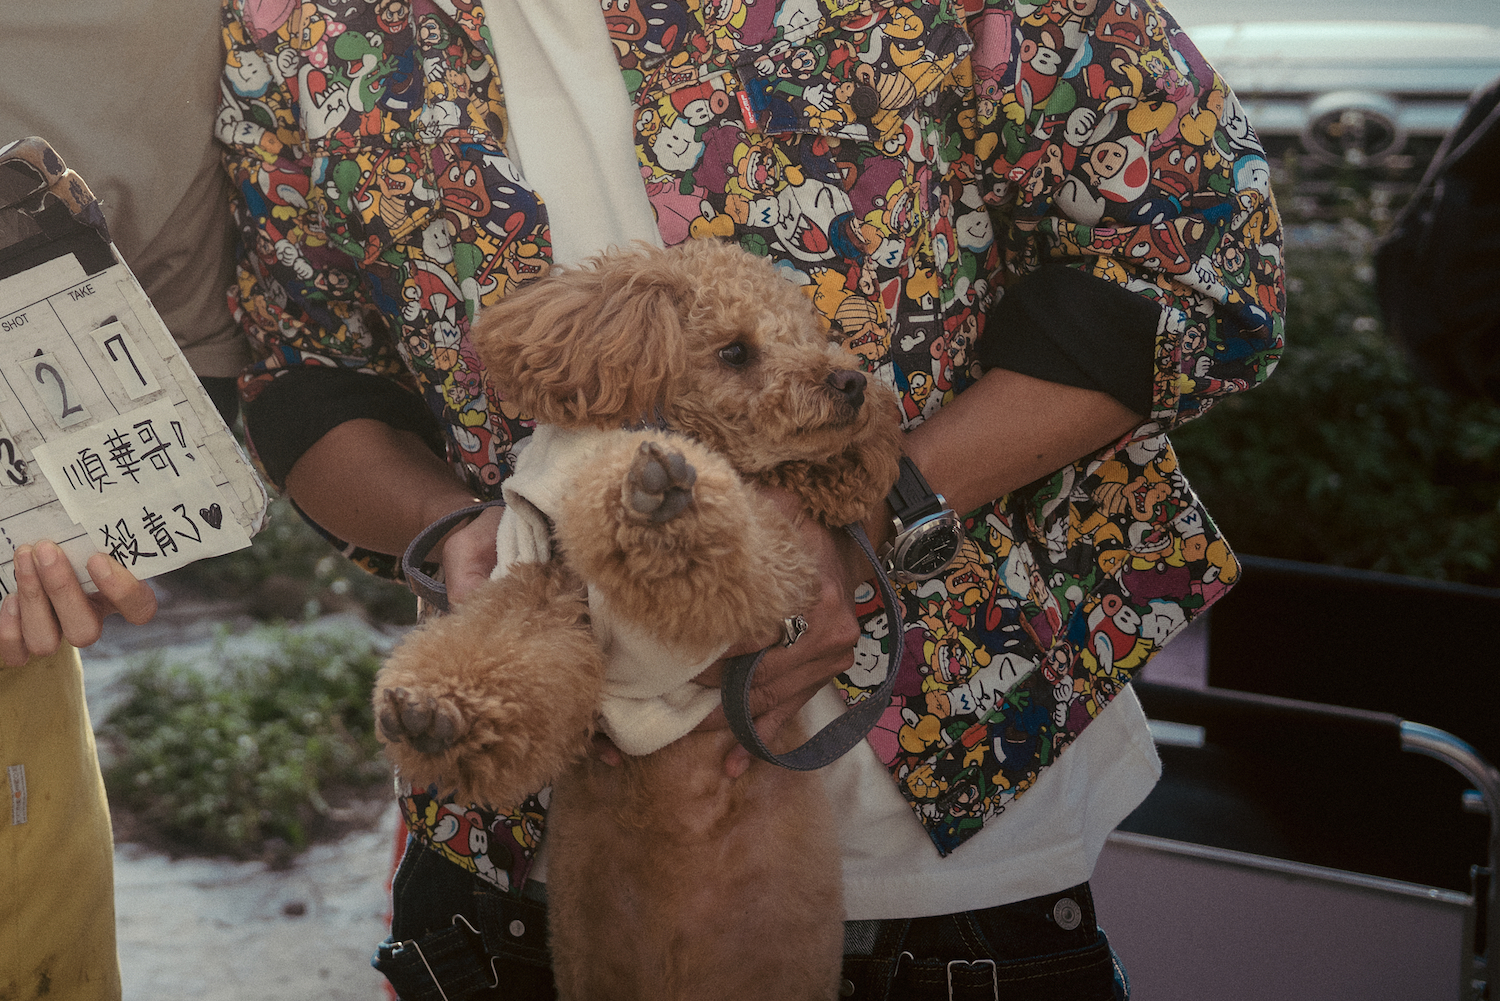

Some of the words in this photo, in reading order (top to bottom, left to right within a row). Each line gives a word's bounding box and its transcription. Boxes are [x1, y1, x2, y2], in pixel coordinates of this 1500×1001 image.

[67, 284, 96, 302] TAKE
[1, 313, 29, 332] SHOT
[103, 333, 148, 387] 7
[35, 362, 84, 419] 2
